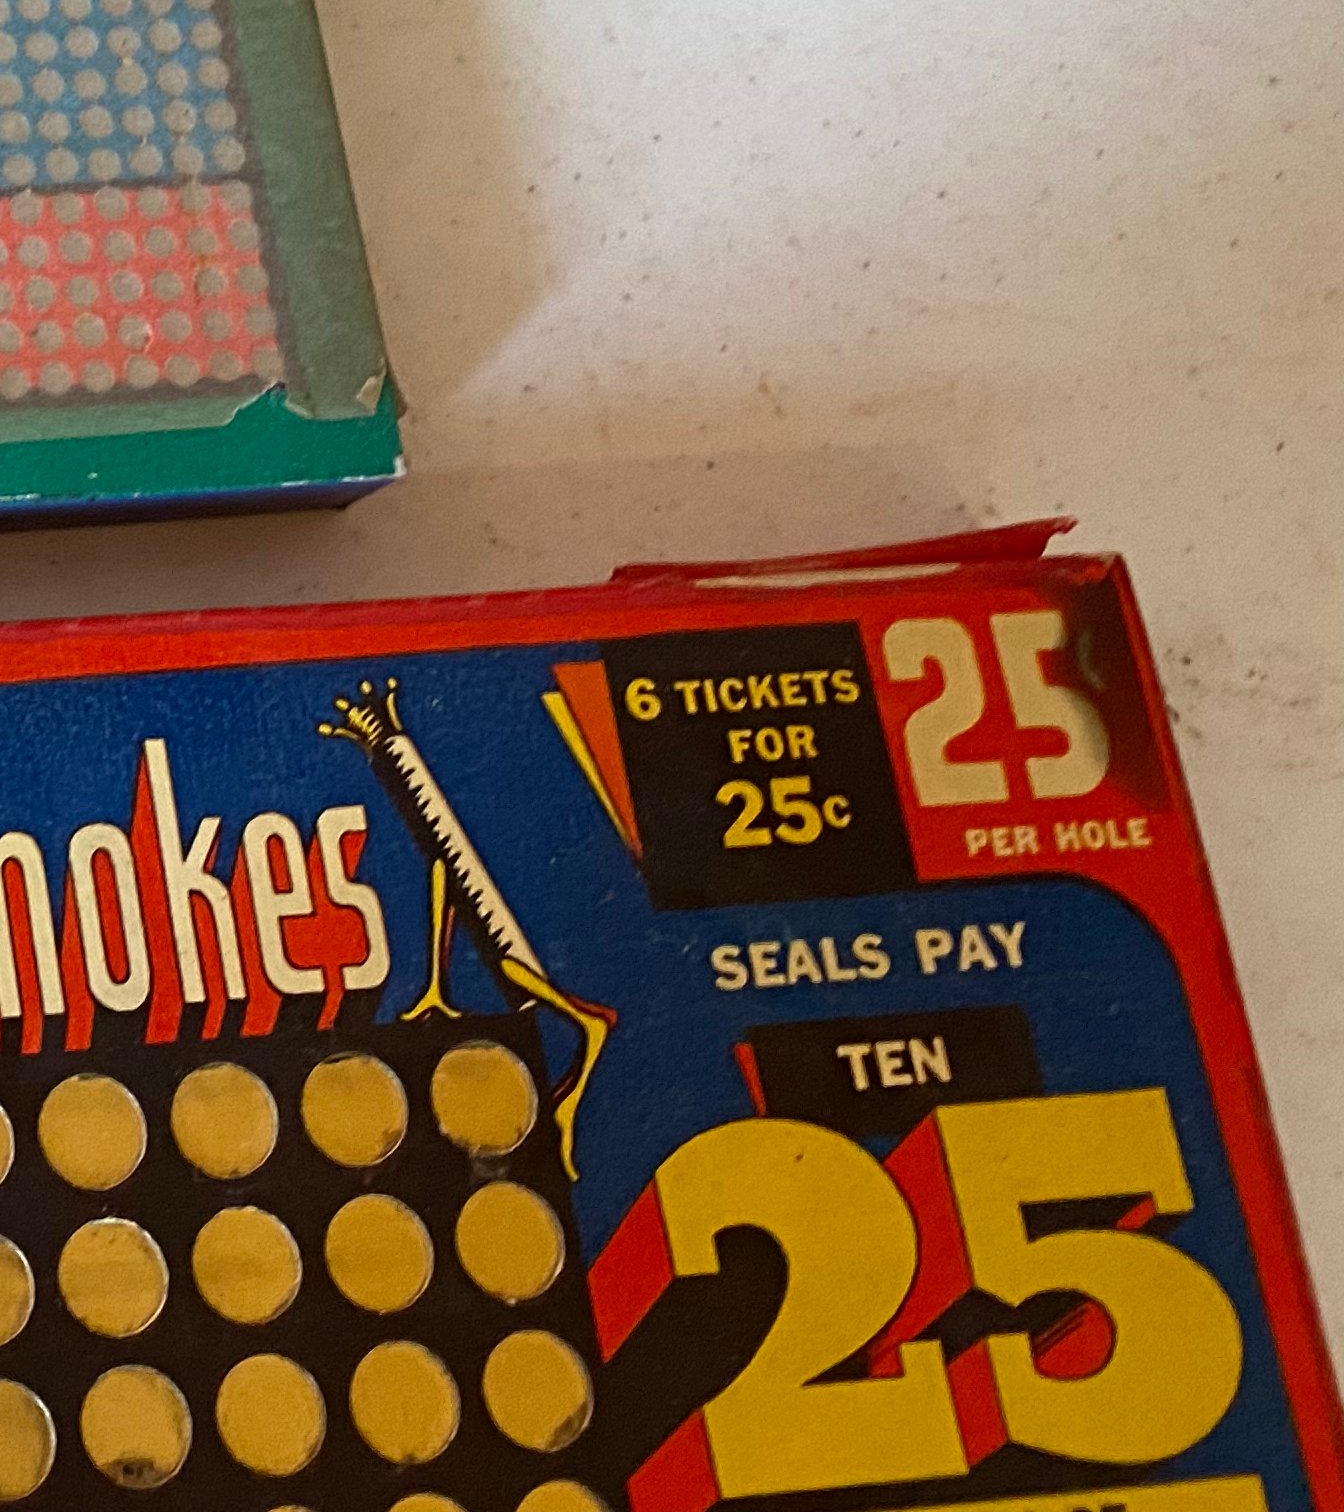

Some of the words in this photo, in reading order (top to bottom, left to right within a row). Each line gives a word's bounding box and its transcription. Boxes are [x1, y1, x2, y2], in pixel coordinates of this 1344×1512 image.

[625, 682, 660, 721] 6
[674, 669, 861, 713] TICKETS
[883, 610, 1110, 808] 25
[729, 727, 817, 764] FOR
[965, 824, 1040, 858] PER
[1055, 819, 1152, 854] HOLE
[710, 933, 891, 991] SEALS
[915, 922, 1029, 975] PAY
[837, 1038, 952, 1091] TEN
[655, 1088, 1244, 1498] 25
